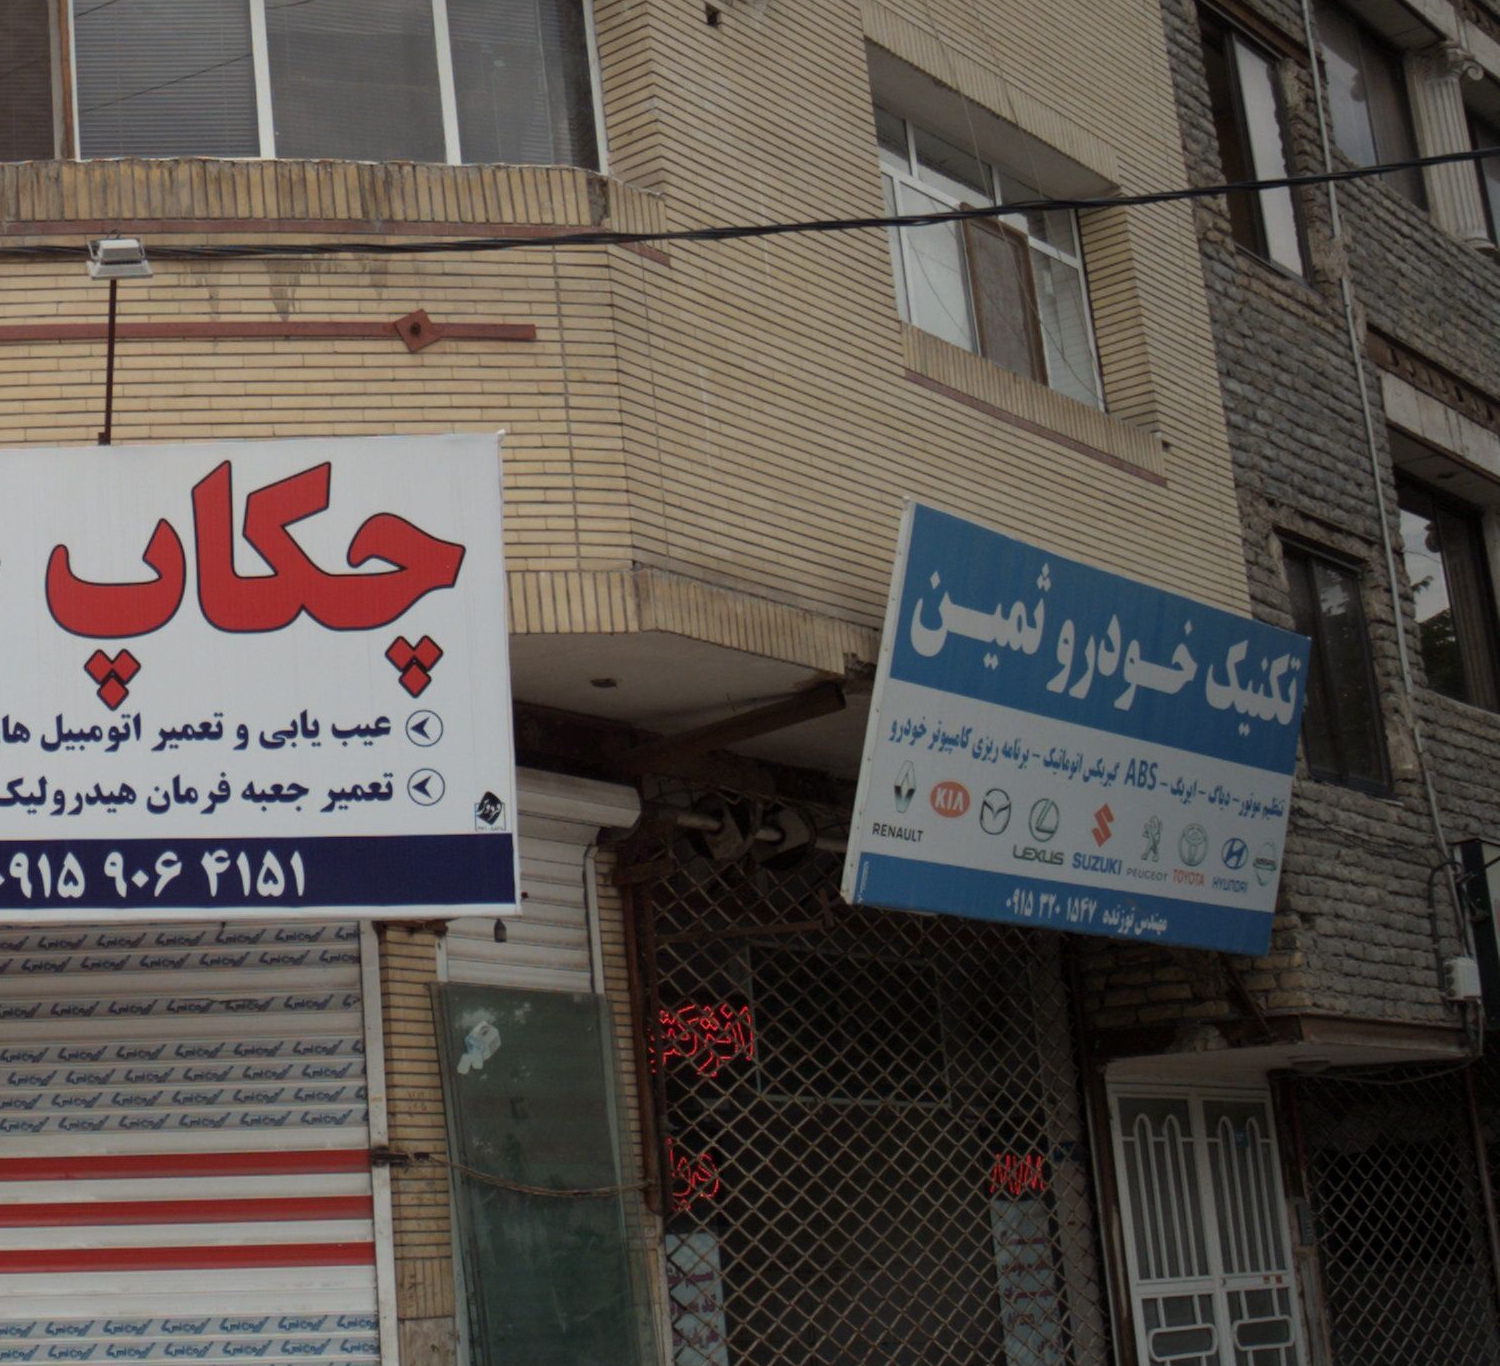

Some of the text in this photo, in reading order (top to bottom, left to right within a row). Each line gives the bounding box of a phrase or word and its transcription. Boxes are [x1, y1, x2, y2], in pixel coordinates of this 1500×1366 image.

[44, 459, 467, 711] چکاپ
[911, 564, 1300, 737] تکنیک خودرو ثمین
[40, 712, 142, 753] اتومبیل
[151, 712, 224, 752] تعمیر
[233, 723, 249, 751] و
[258, 709, 321, 750] یابی
[331, 715, 392, 747] عیب
[888, 716, 927, 745] خودرو
[927, 721, 973, 754] کامپیوتر
[972, 735, 999, 763] ریزی
[1001, 738, 1030, 769] برنامه
[1043, 747, 1084, 780] اتوماتیک
[1082, 757, 1121, 788] گیربکس
[1124, 757, 1159, 791] ABS
[146, 771, 231, 815] فرمان
[241, 781, 310, 812] جعبه
[320, 772, 394, 813] تعمیر
[935, 787, 964, 812] KIA
[871, 822, 924, 843] RENAULT
[1012, 844, 1065, 866] LEXUS
[1072, 852, 1123, 876] SUZUKI
[103, 851, 182, 898] ۹۰۶
[200, 849, 305, 897] ۴۱۵۱
[1126, 867, 1168, 883] PEUGEOT
[1172, 869, 1205, 887] TOYOTA
[1005, 887, 1034, 917] ۰۹۱۵
[1134, 912, 1168, 936] مهندس
